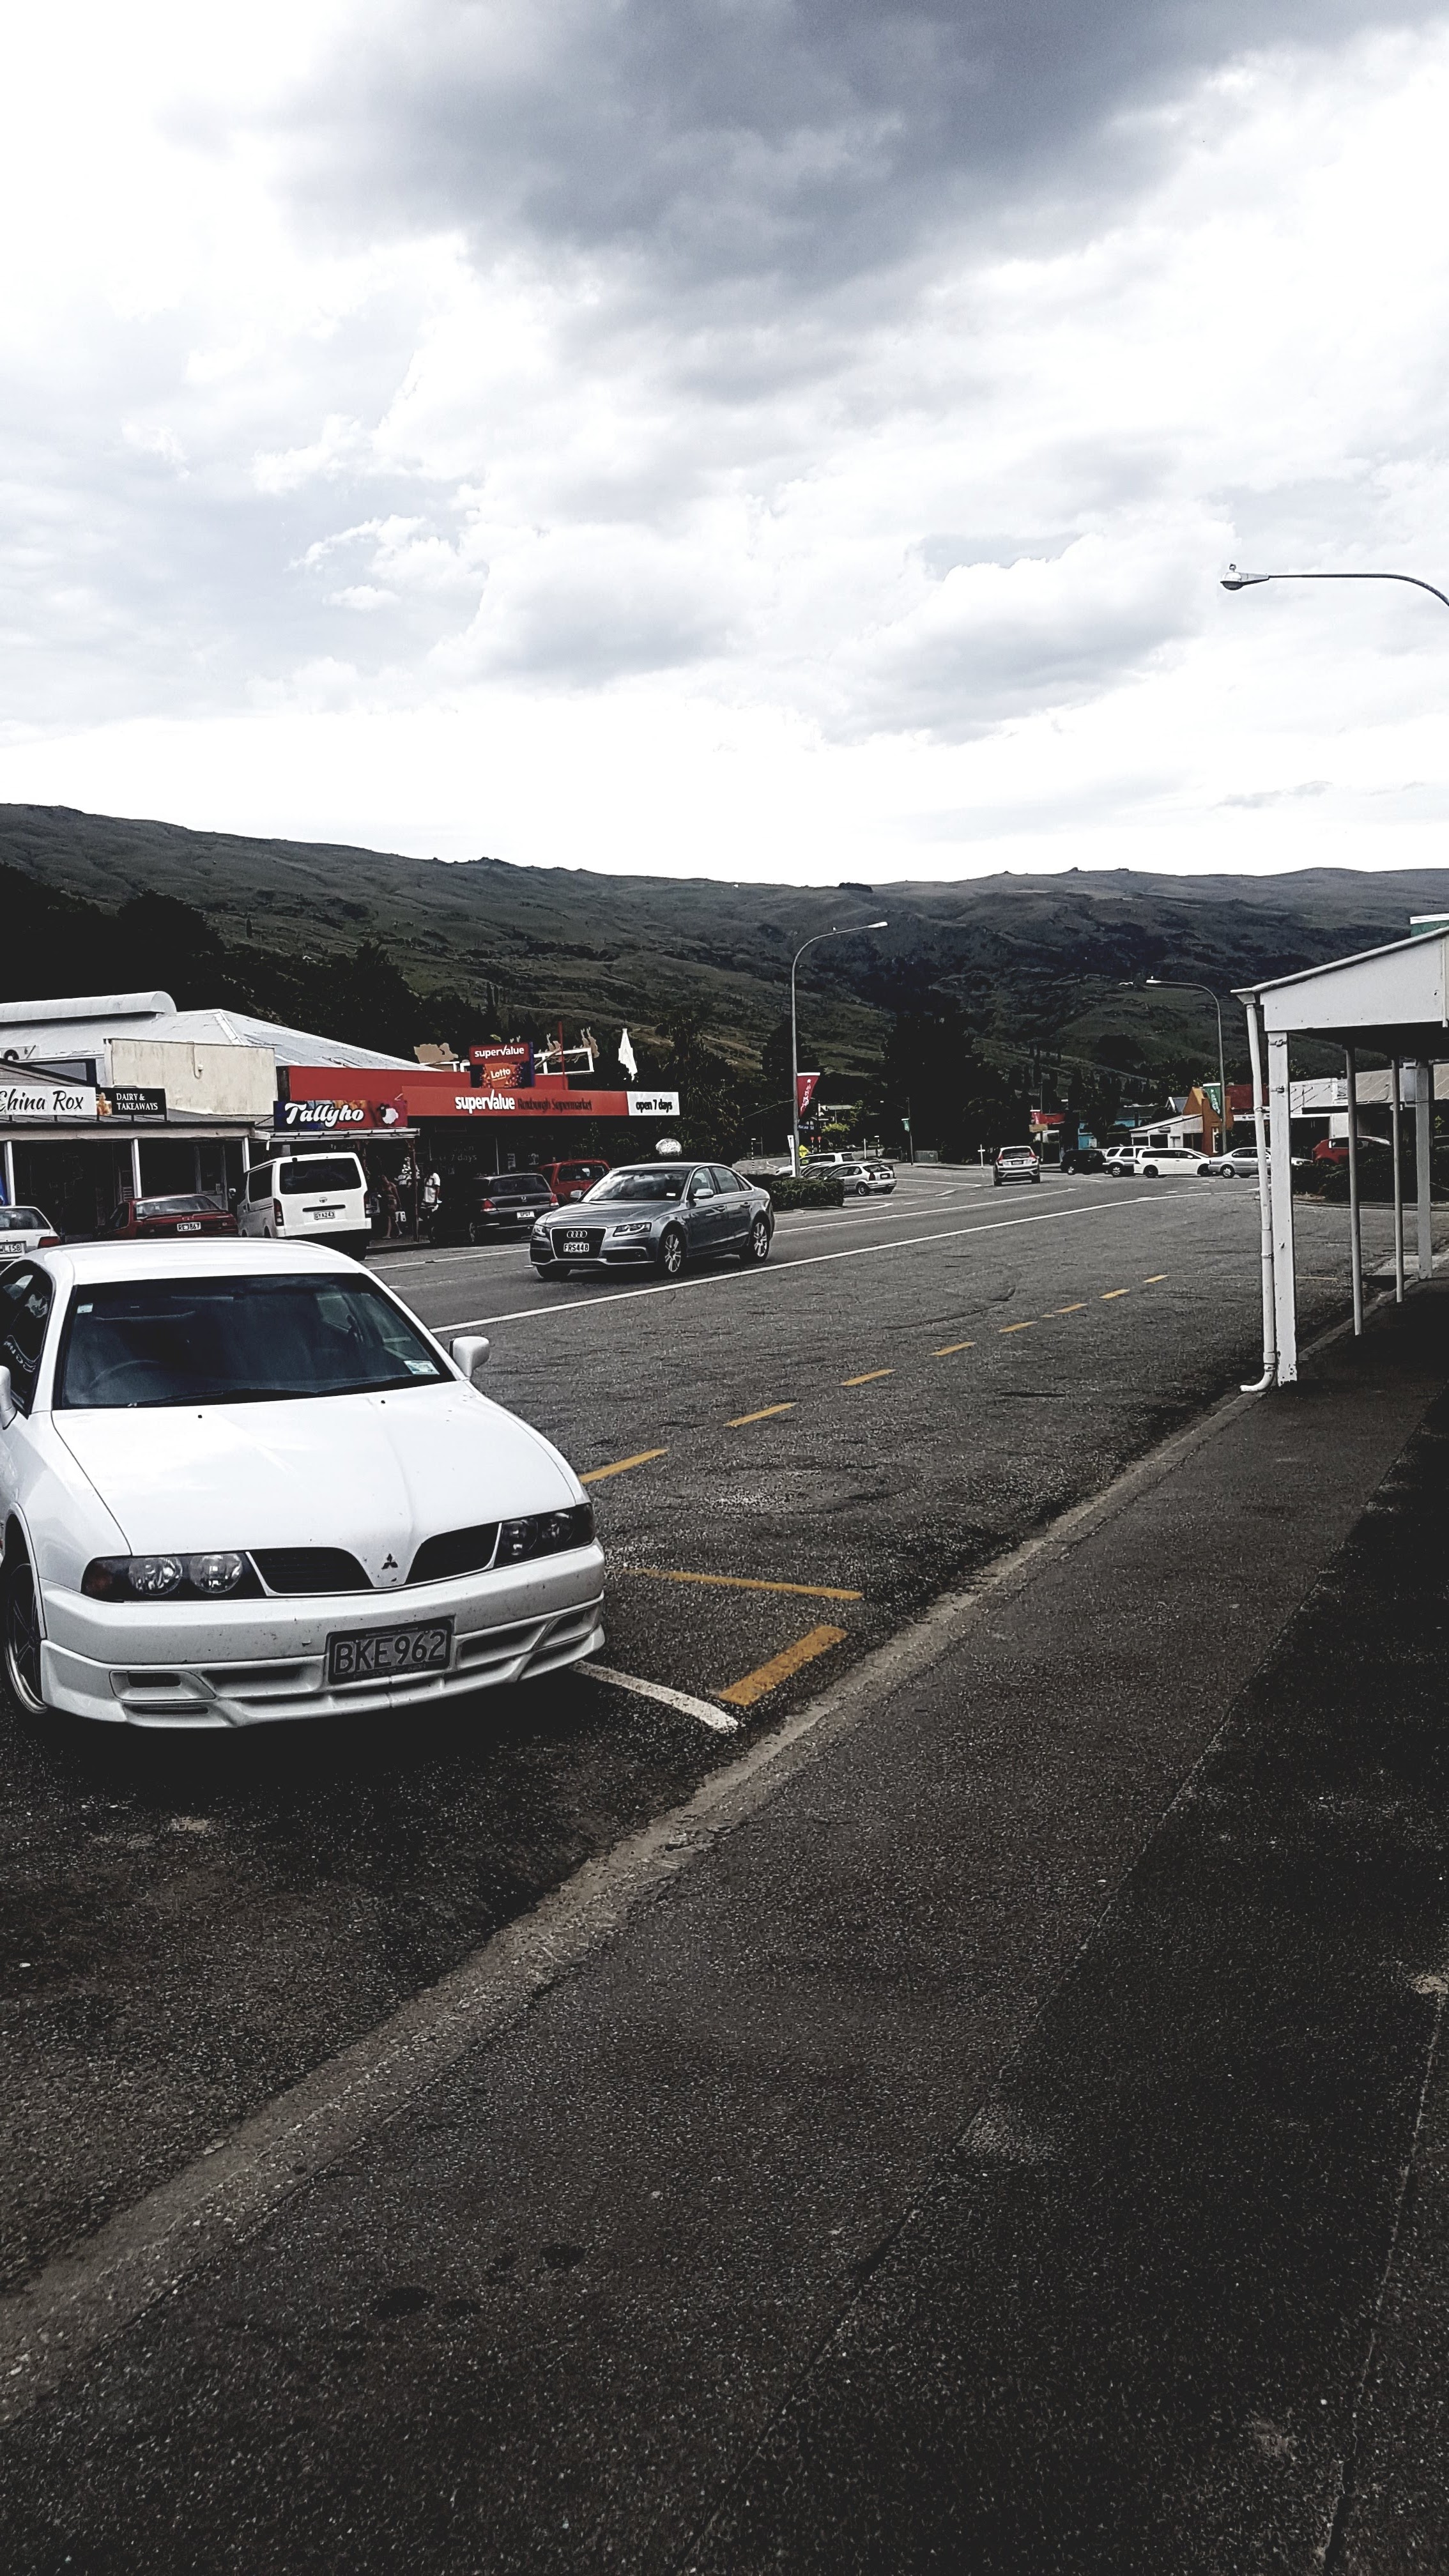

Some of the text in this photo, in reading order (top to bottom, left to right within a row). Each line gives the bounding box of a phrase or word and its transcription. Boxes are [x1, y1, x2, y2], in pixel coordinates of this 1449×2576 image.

[490, 1068, 511, 1079] Lotto
[52, 1090, 84, 1111] Rox
[518, 1098, 551, 1113] Roxburgh
[551, 1098, 593, 1113] Supermarket
[636, 1098, 673, 1113] open 7 days
[284, 1103, 364, 1128] Tallyho
[457, 1153, 477, 1162] days
[335, 1631, 445, 1674] BKE962
